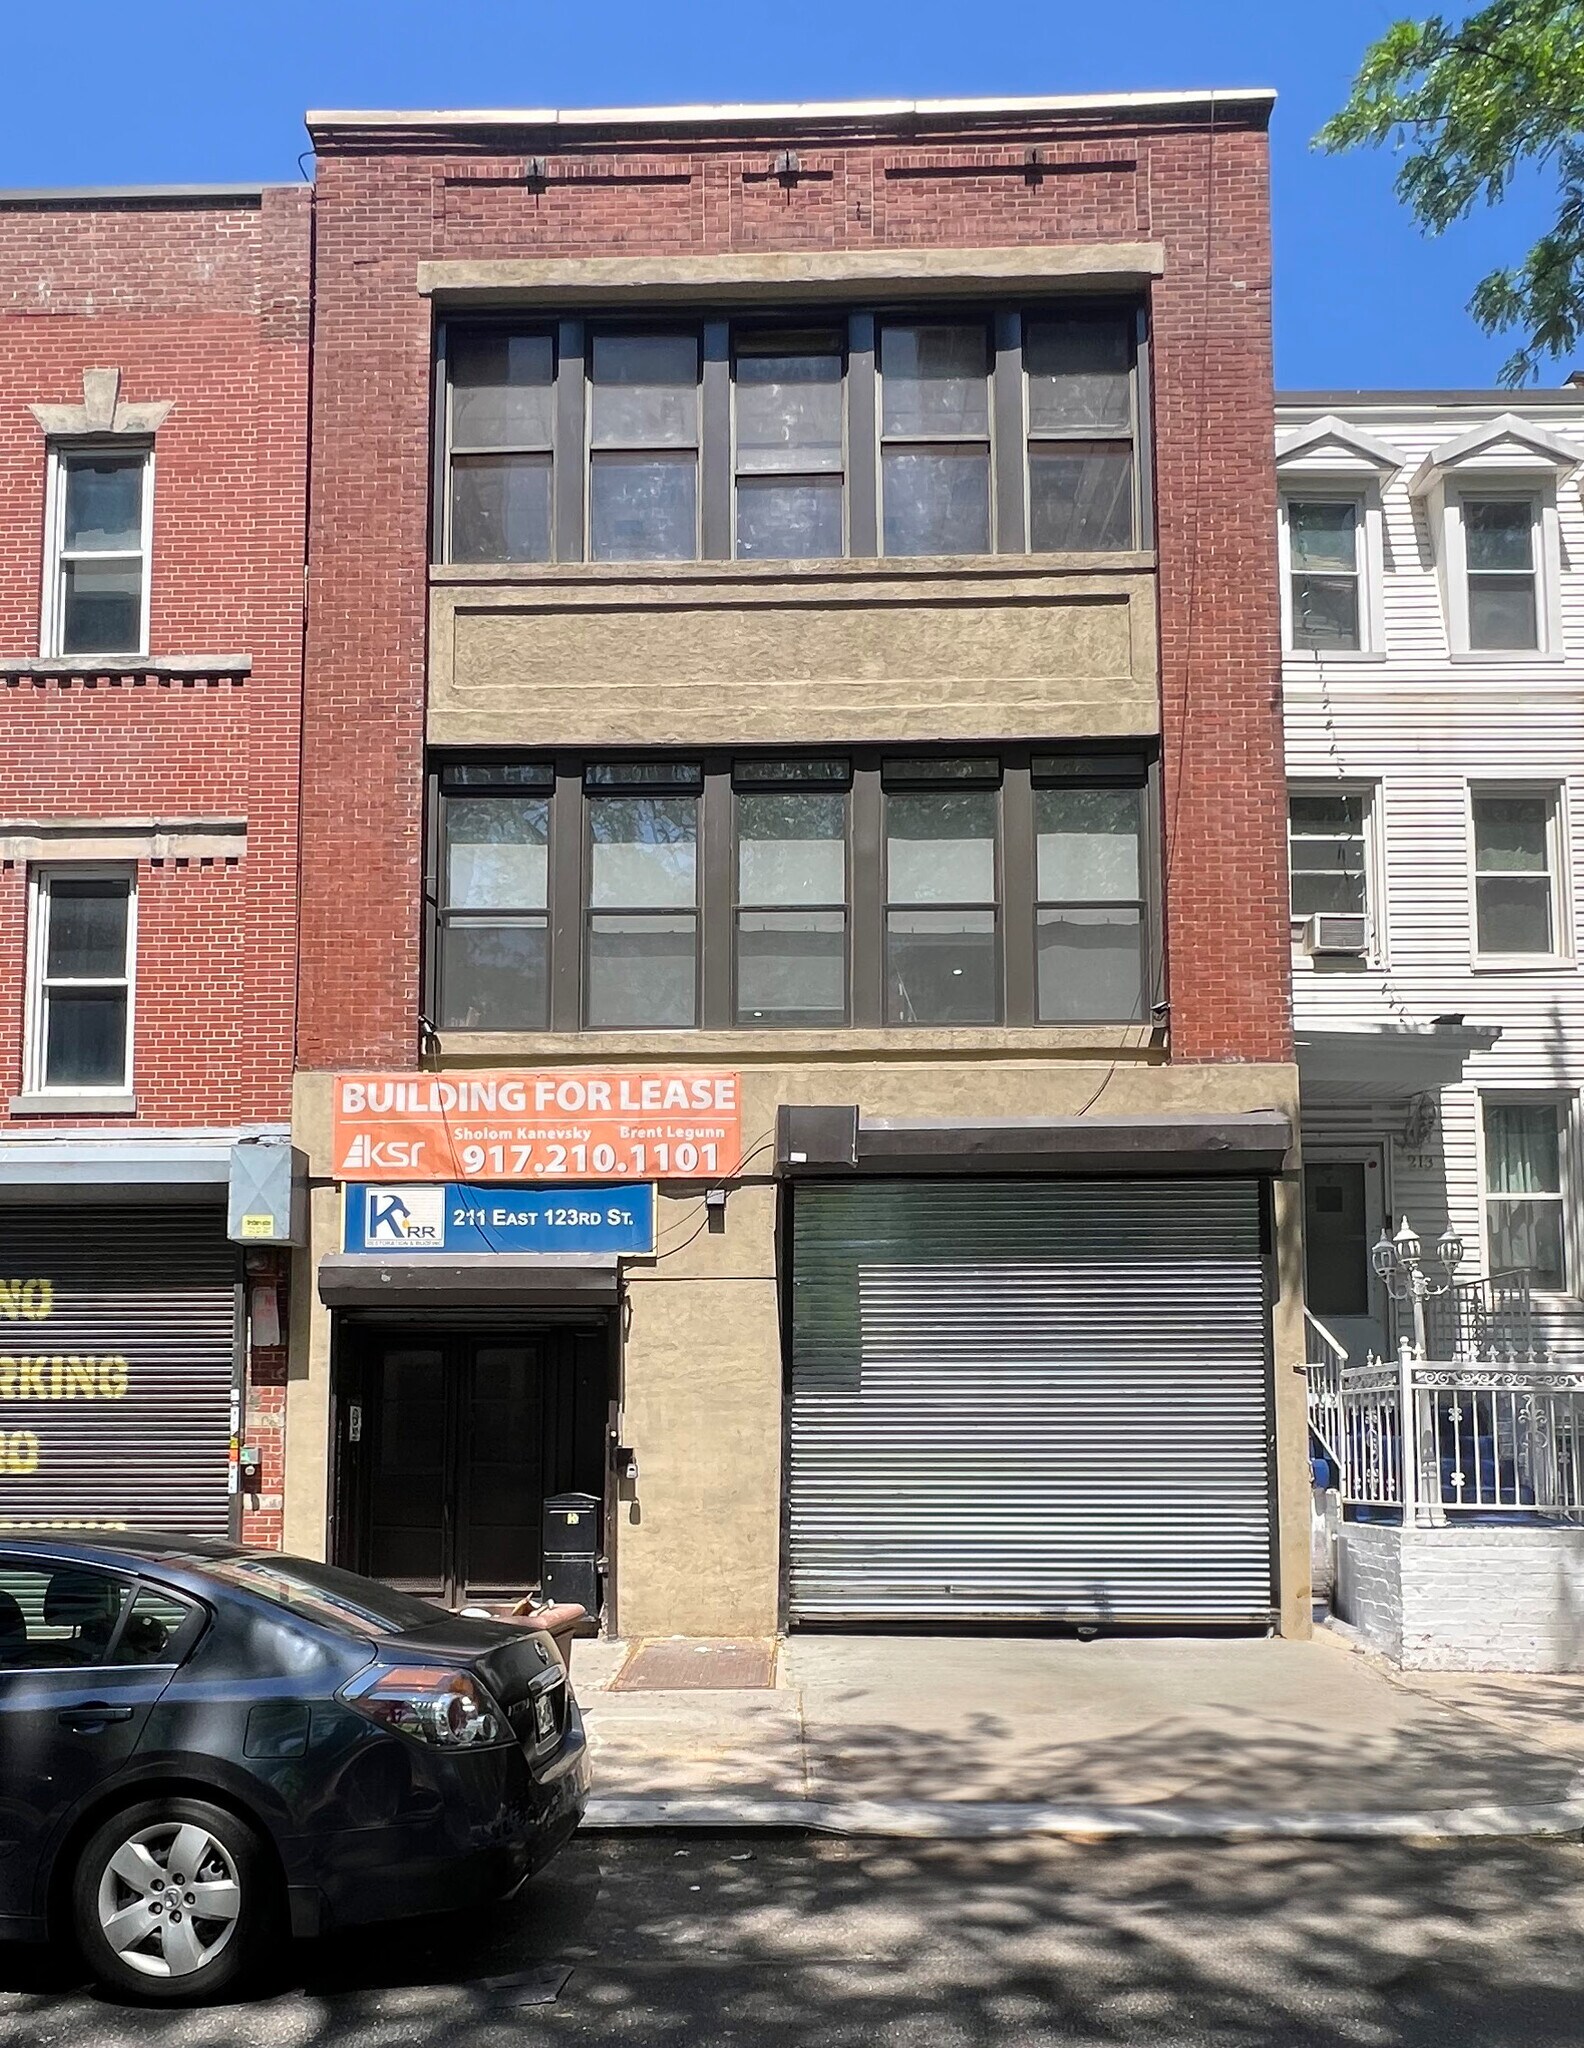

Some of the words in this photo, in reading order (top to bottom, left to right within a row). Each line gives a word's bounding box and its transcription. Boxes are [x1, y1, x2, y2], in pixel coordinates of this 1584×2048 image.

[342, 1081, 527, 1114] BUILDING
[534, 1080, 613, 1112] FOR
[619, 1079, 736, 1111] LEASE
[453, 1127, 513, 1141] Sholom
[516, 1126, 592, 1142] Kanevsky
[619, 1125, 663, 1139] Brent
[666, 1125, 726, 1141] Legunn
[461, 1143, 719, 1175] 917.210.1101
[1407, 1155, 1434, 1169] 213
[452, 1208, 487, 1226] 211
